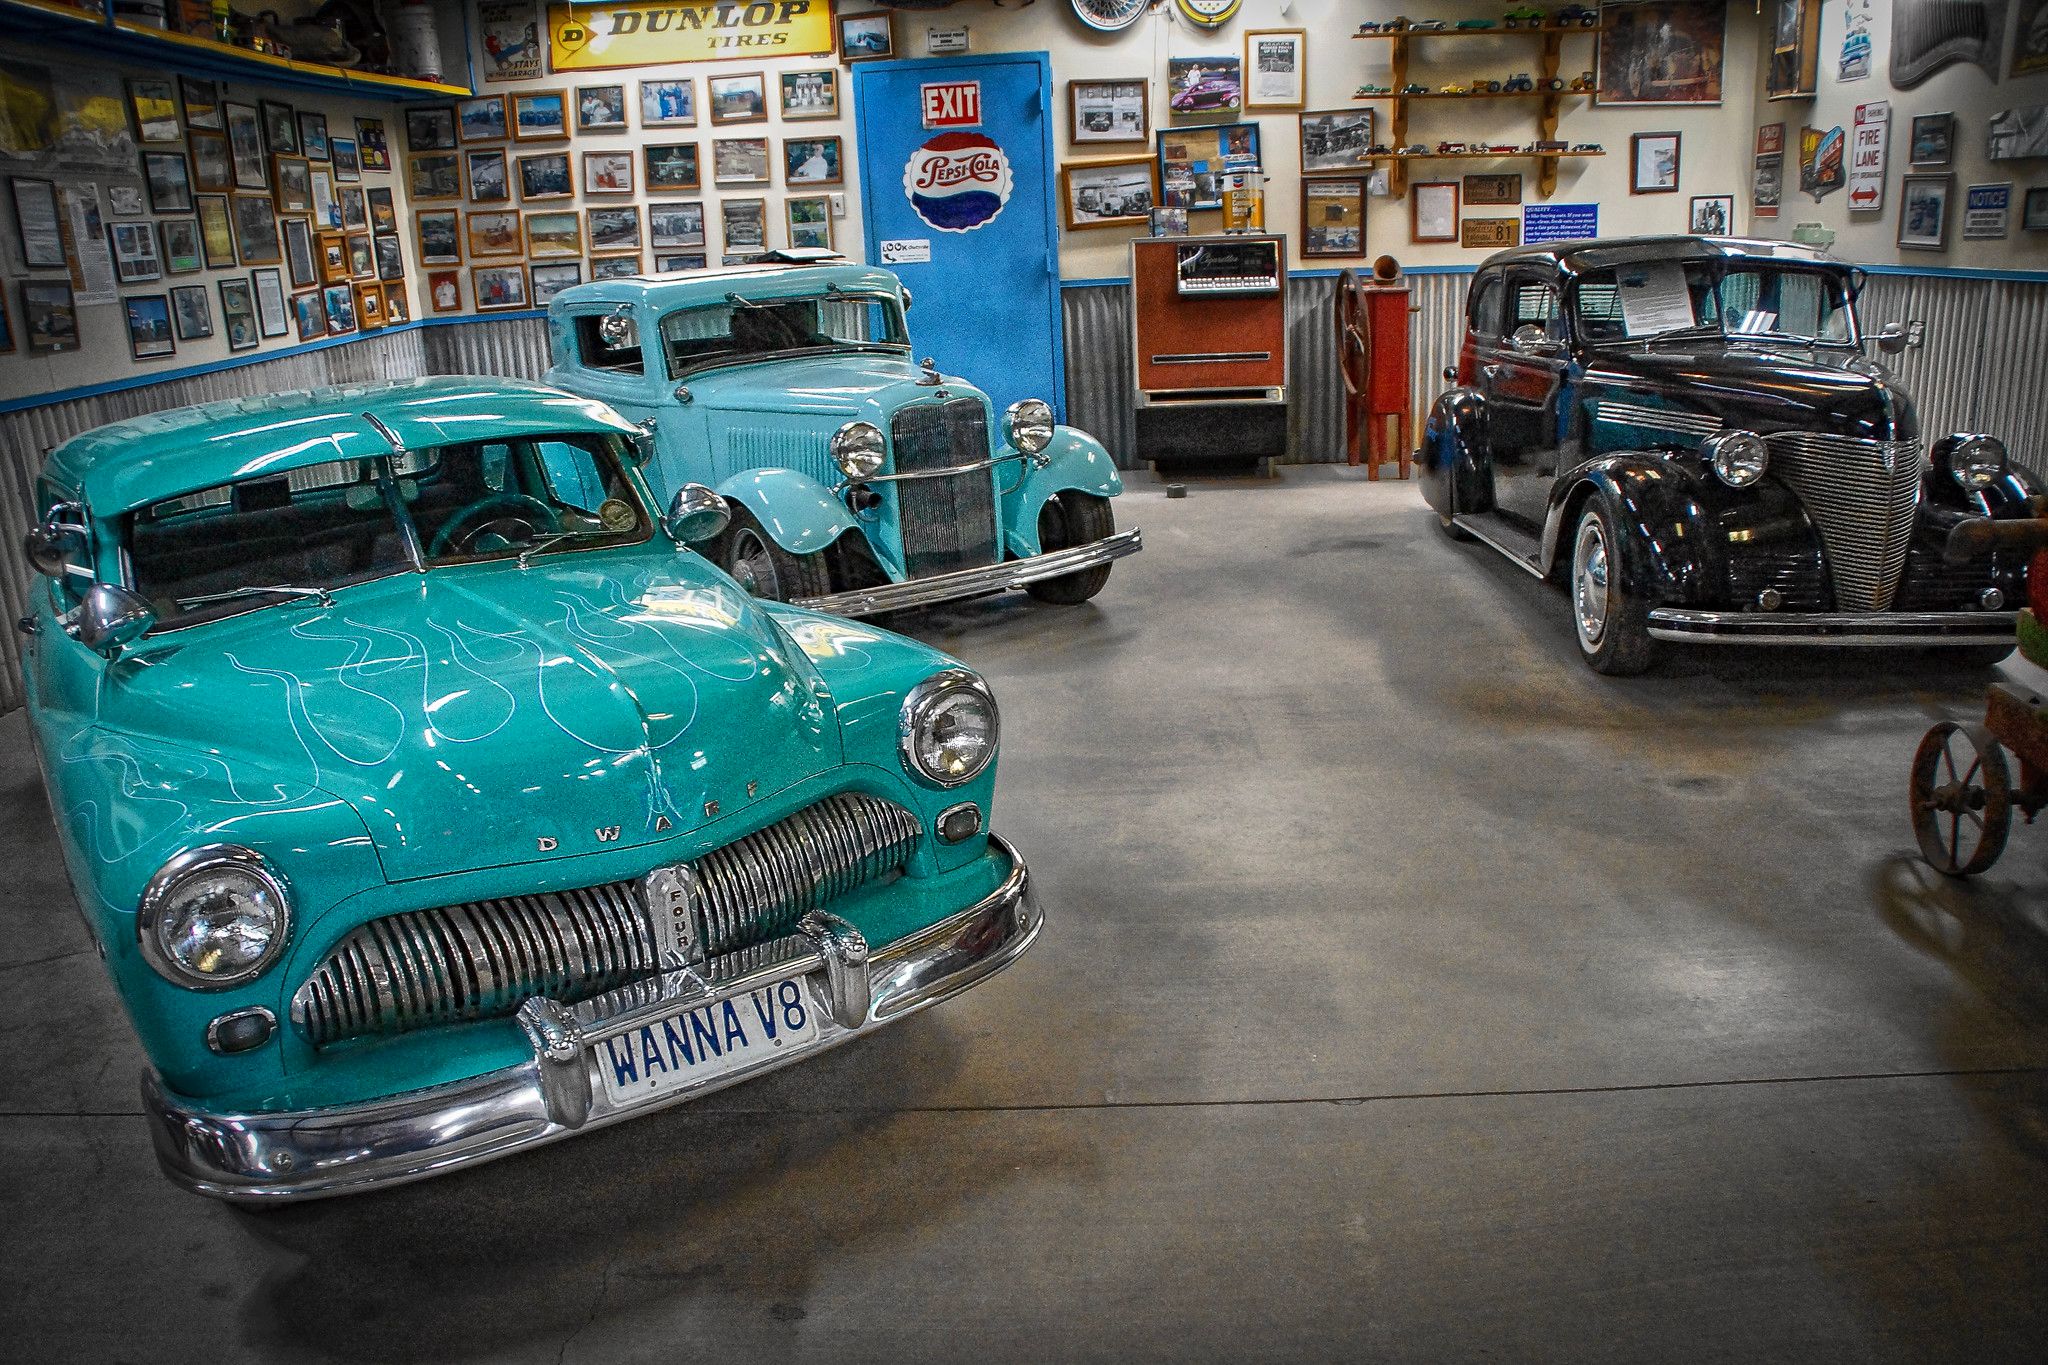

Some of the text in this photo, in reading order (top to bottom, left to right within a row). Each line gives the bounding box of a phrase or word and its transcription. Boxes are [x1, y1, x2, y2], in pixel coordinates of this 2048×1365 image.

[607, 0, 810, 36] DUNLOP
[562, 29, 584, 43] D
[707, 32, 789, 49] TIRES
[513, 59, 540, 69] STAYS
[925, 86, 976, 120] EXIT
[1858, 128, 1880, 147] FIRE
[1855, 149, 1880, 168] LANE
[1497, 181, 1512, 197] 81
[1971, 190, 2007, 206] NOTICE
[1496, 225, 1511, 241] 81
[883, 242, 908, 252] LOOK
[669, 889, 690, 949] FOUR
[606, 979, 808, 1088] WANNA V8
